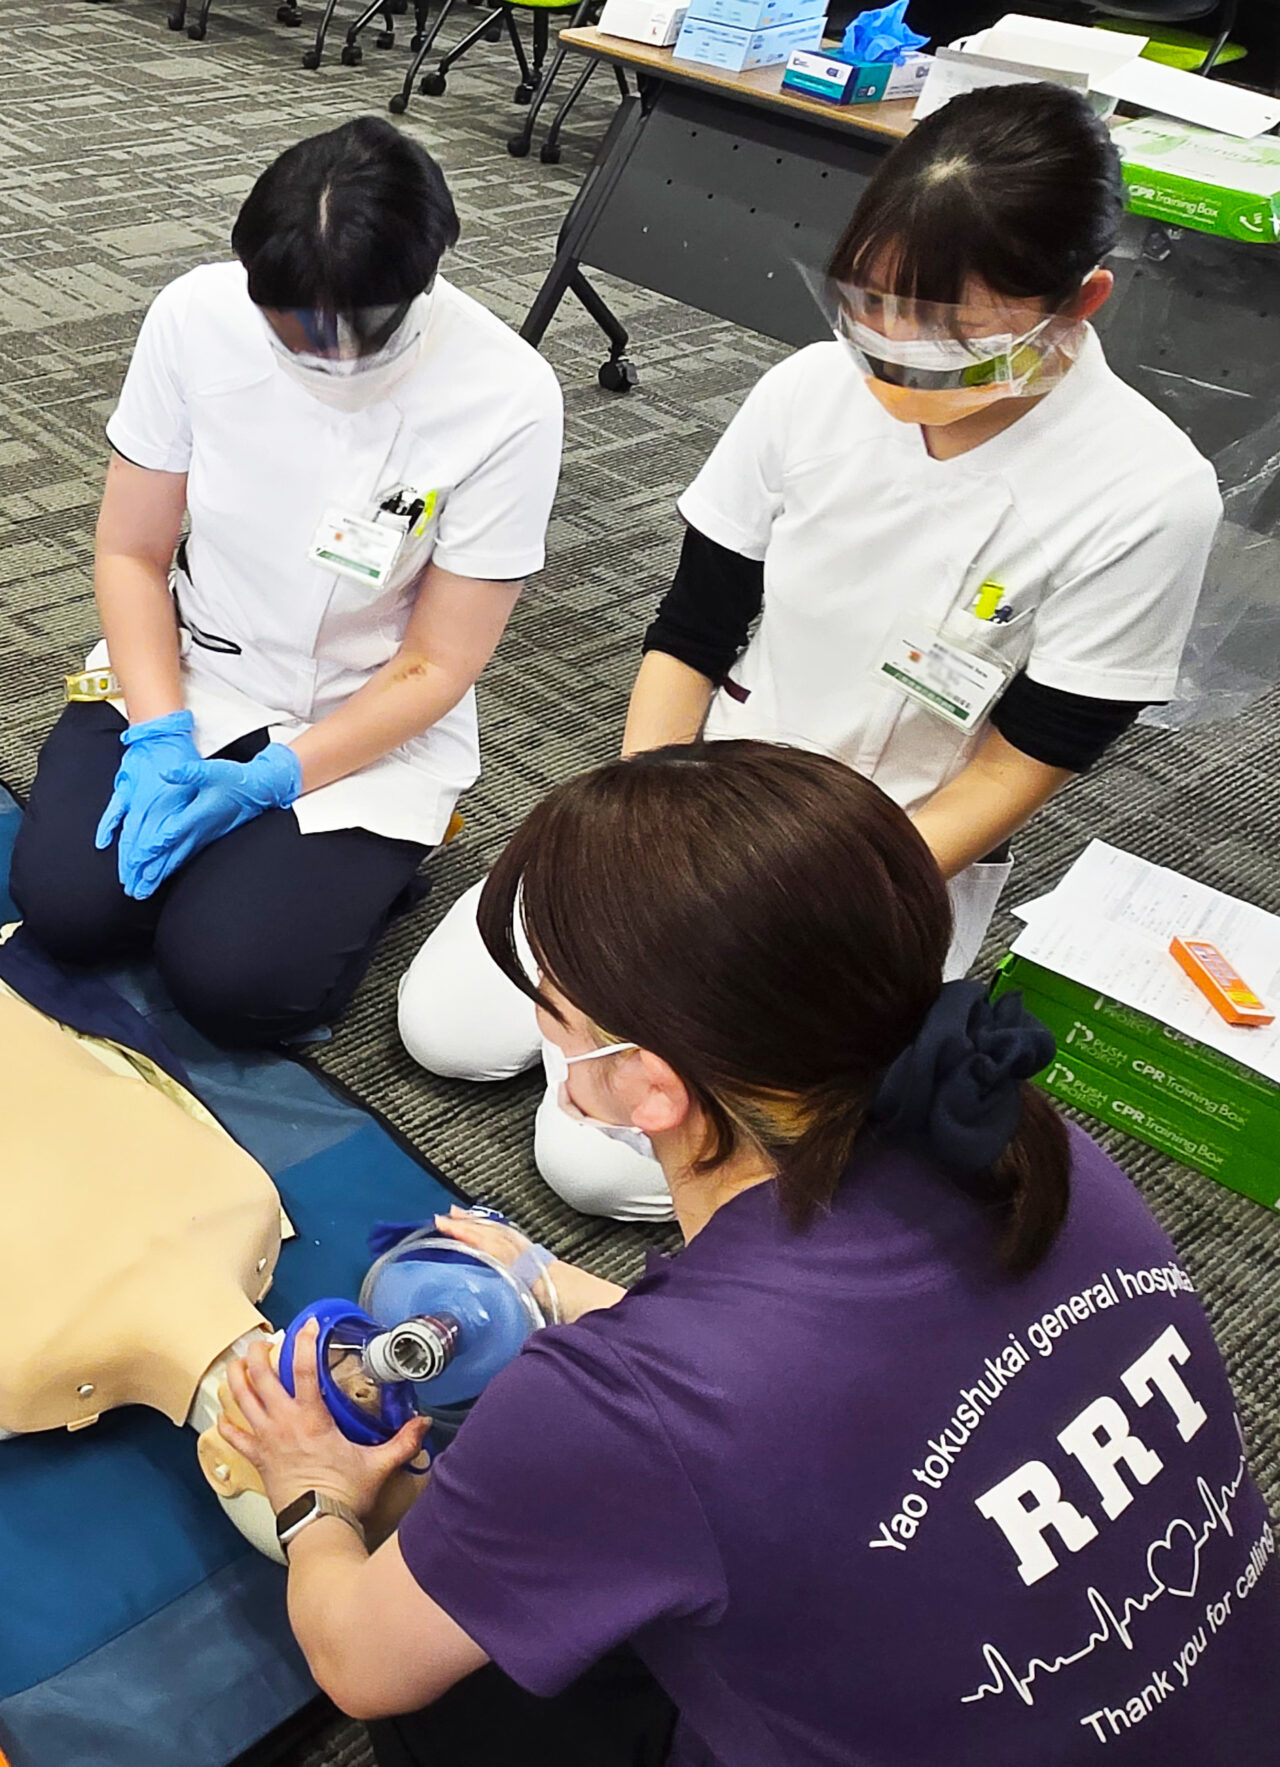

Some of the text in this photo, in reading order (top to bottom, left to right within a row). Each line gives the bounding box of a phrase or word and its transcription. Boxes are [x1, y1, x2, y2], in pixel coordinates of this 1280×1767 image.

[1128, 185, 1219, 217] CPR Training Box
[1075, 1041, 1122, 1068] PROJECT
[1093, 1038, 1128, 1060] PUSH
[1055, 1082, 1102, 1109] PROJECT
[1073, 1079, 1108, 1100] PUSH
[1132, 1060, 1247, 1126] CPR Training Box
[1112, 1101, 1224, 1165] CPR Training Box
[869, 1493, 929, 1552] Yao
[911, 1333, 1031, 1489] tokushukai
[1027, 1272, 1120, 1357] general
[974, 1324, 1208, 1587] RRT
[1080, 1671, 1175, 1744] Thank
[1172, 1627, 1208, 1687] you
[1206, 1592, 1232, 1634] for
